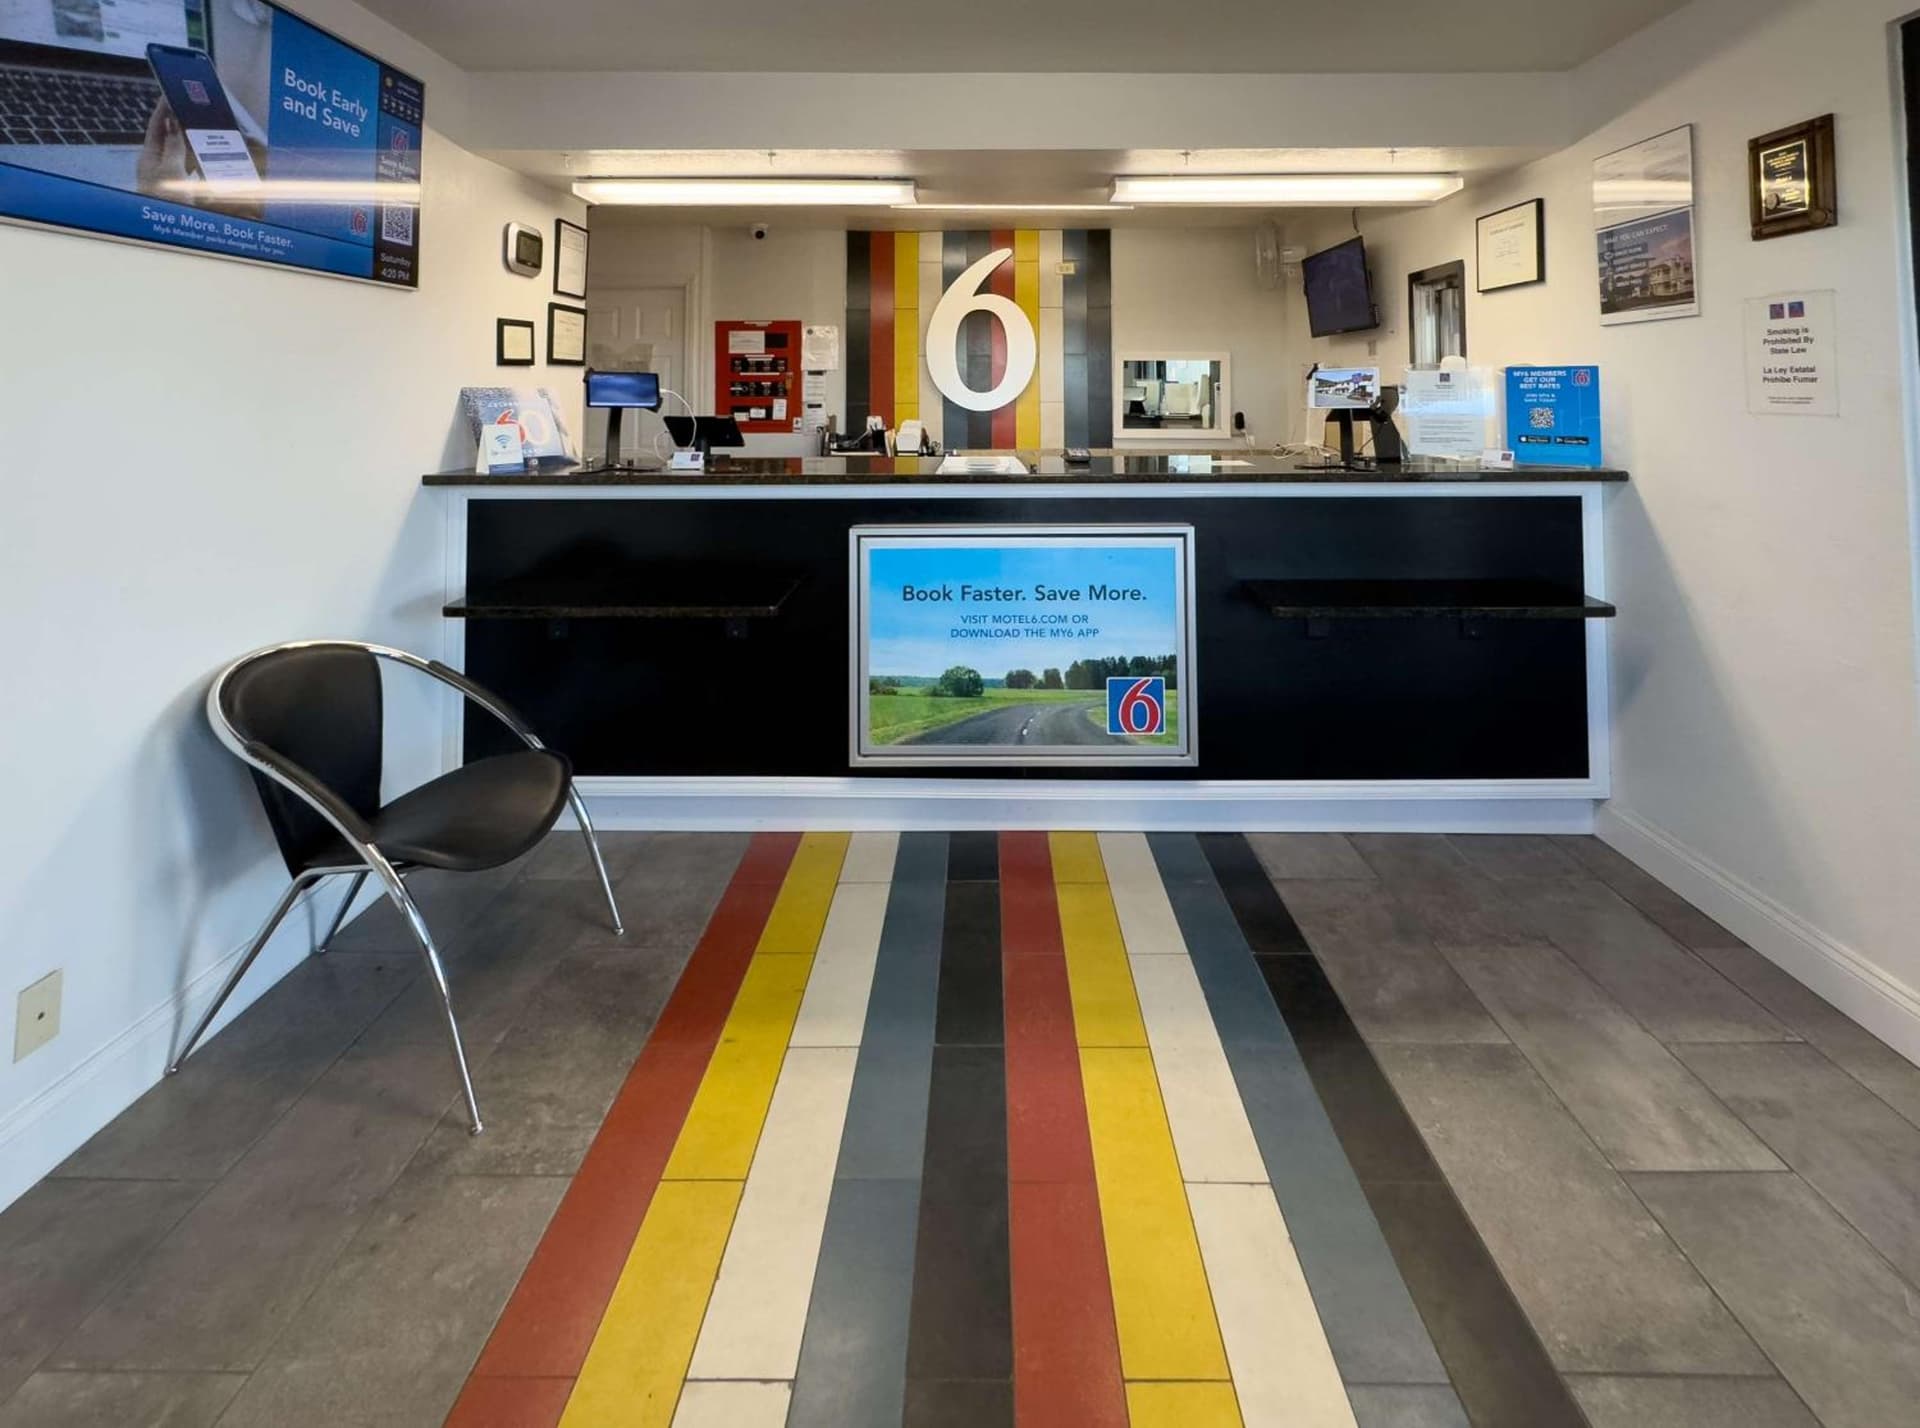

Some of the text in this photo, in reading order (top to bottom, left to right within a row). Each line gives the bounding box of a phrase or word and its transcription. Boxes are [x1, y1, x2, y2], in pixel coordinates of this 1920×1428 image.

[284, 67, 328, 102] Book
[332, 89, 368, 122] Early
[283, 96, 317, 120] and
[322, 107, 360, 137] Save
[141, 206, 294, 248] Save More. Book Faster.
[926, 247, 1037, 412] 6
[1767, 328, 1800, 336] Smoking
[1762, 336, 1815, 345] Prohibited By
[1769, 347, 1789, 355] State
[1774, 367, 1788, 375] Ley
[1789, 365, 1816, 373] Estatal
[902, 584, 1147, 601] Book Faster. Save More.
[960, 614, 1089, 624] VISIT MOTEL6.COM OR
[950, 628, 1100, 638] DOWNLOAD THE MY6 APP
[1119, 677, 1161, 735] 6
